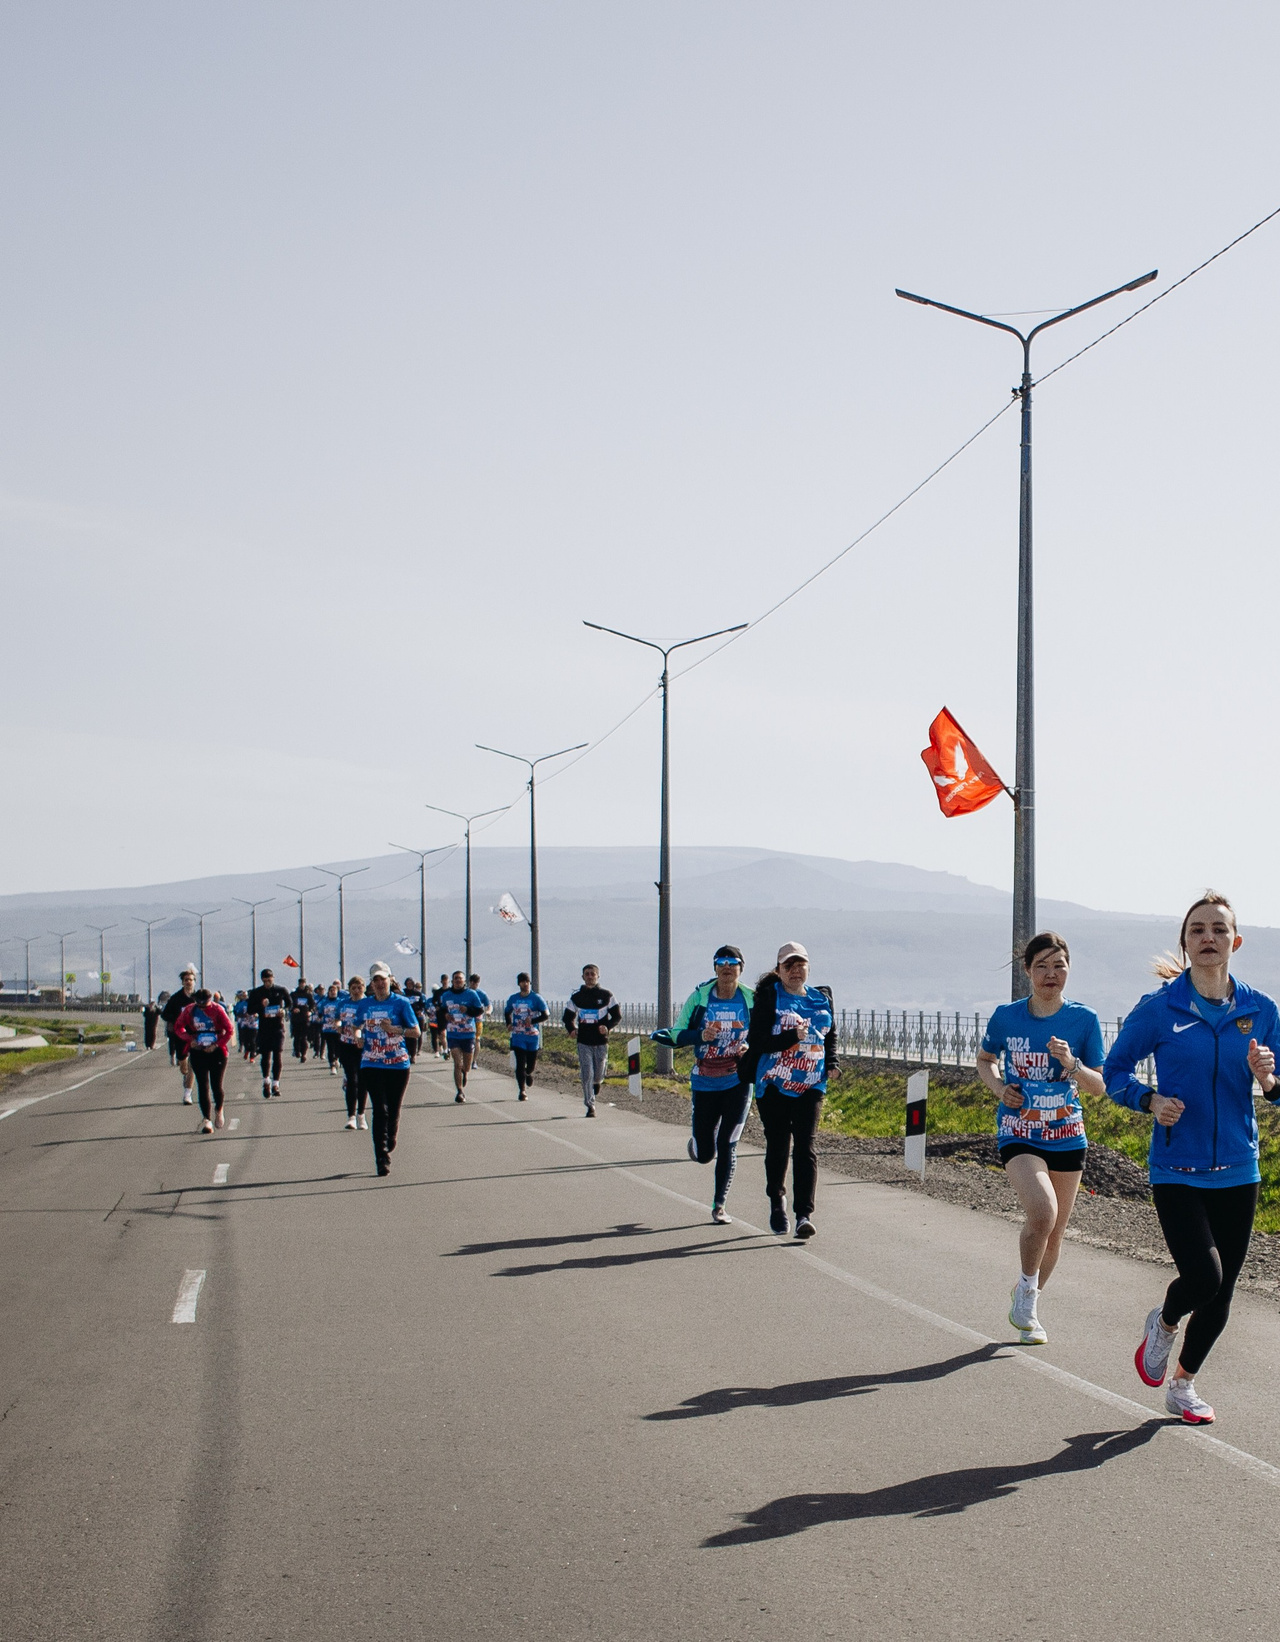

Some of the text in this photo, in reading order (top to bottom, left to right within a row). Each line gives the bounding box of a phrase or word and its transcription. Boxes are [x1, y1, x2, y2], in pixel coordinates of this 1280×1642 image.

[1006, 1037, 1030, 1052] 2024
[1011, 1052, 1049, 1067] #МЕЧТА
[1032, 1094, 1065, 1108] 20005
